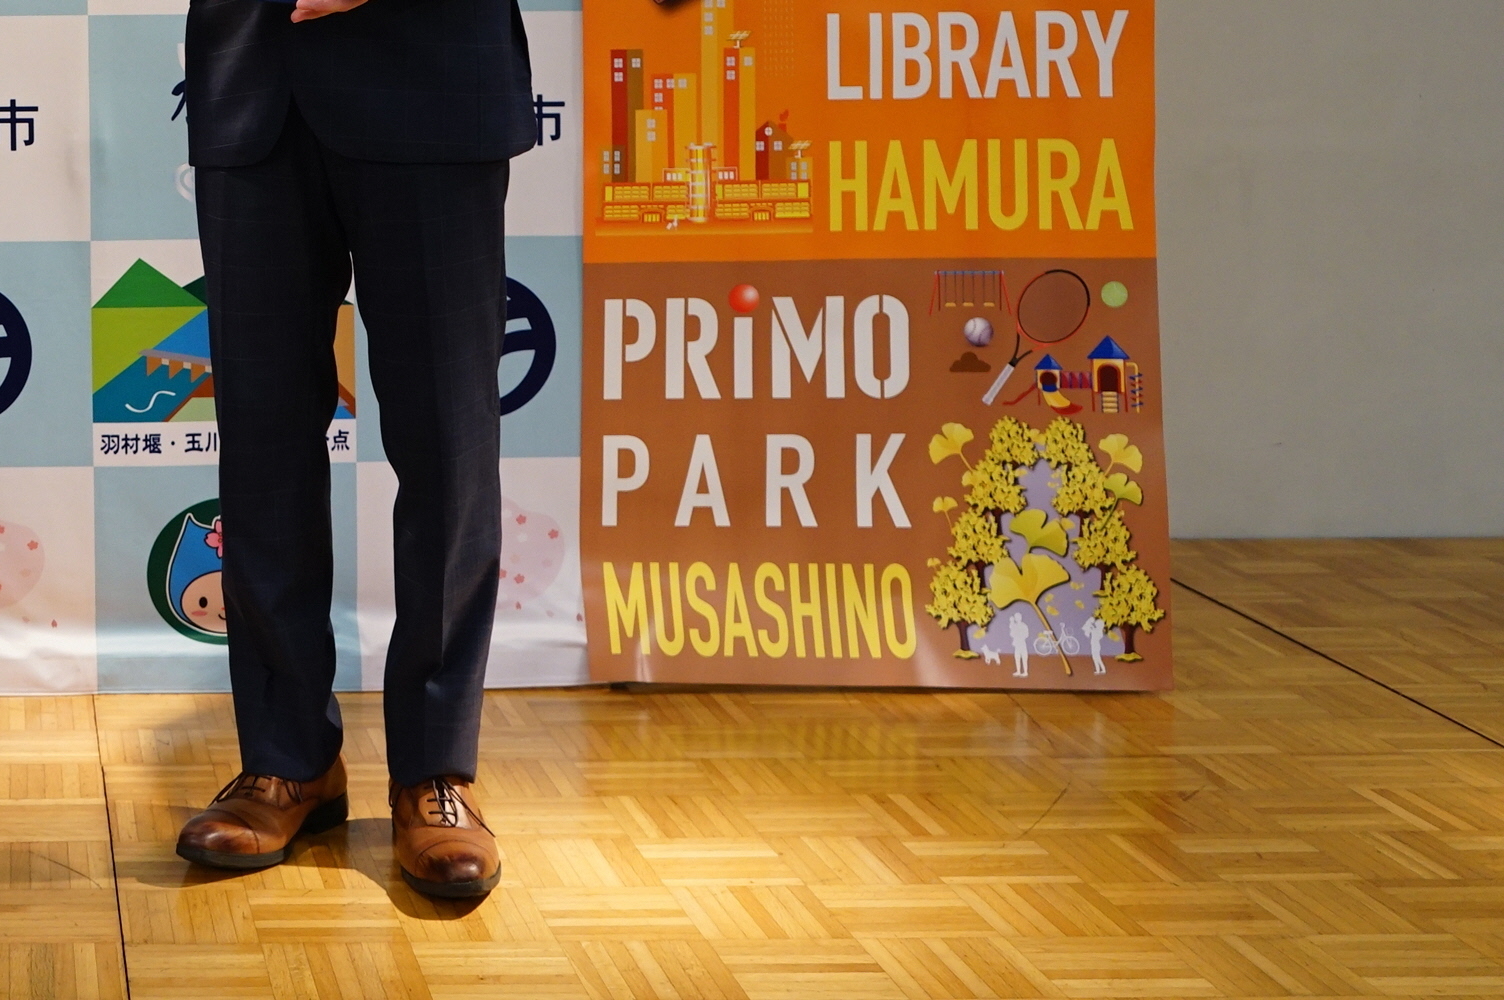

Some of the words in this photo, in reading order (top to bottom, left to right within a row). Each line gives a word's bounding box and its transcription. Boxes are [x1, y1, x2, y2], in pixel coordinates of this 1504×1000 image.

[826, 9, 1129, 101] LIBRARY
[829, 138, 1135, 233] HAMURA
[601, 432, 912, 528] PARK
[603, 561, 917, 659] MUSASHINO
